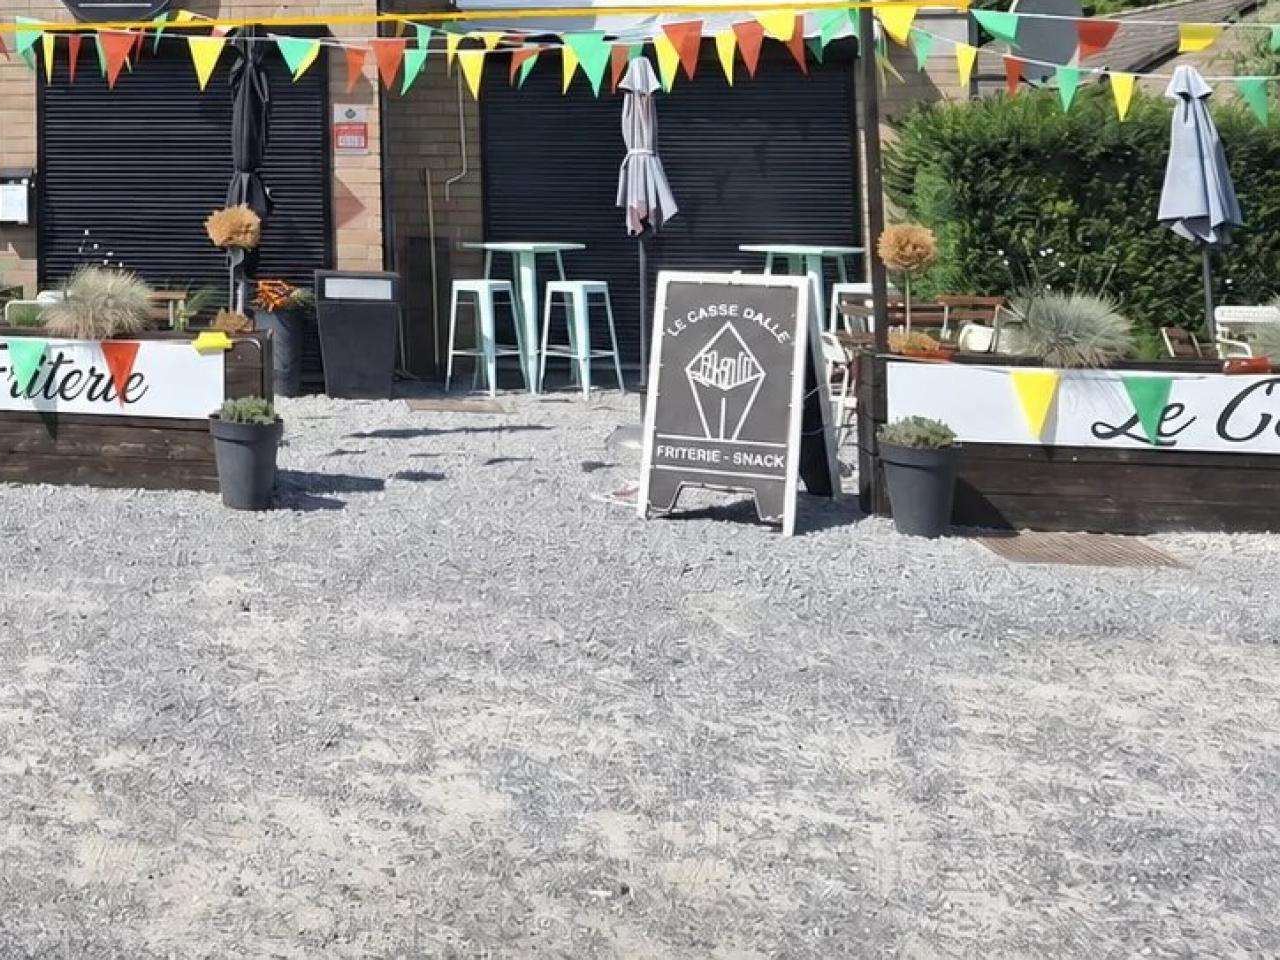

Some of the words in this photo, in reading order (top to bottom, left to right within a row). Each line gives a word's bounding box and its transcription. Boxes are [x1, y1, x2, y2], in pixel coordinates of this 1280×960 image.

[666, 319, 688, 337] LE
[687, 303, 739, 322] CASSE
[742, 307, 792, 344] DALLE
[1216, 377, 1280, 443] C
[656, 440, 721, 463] FRITERIE
[733, 451, 785, 469] SNACK
